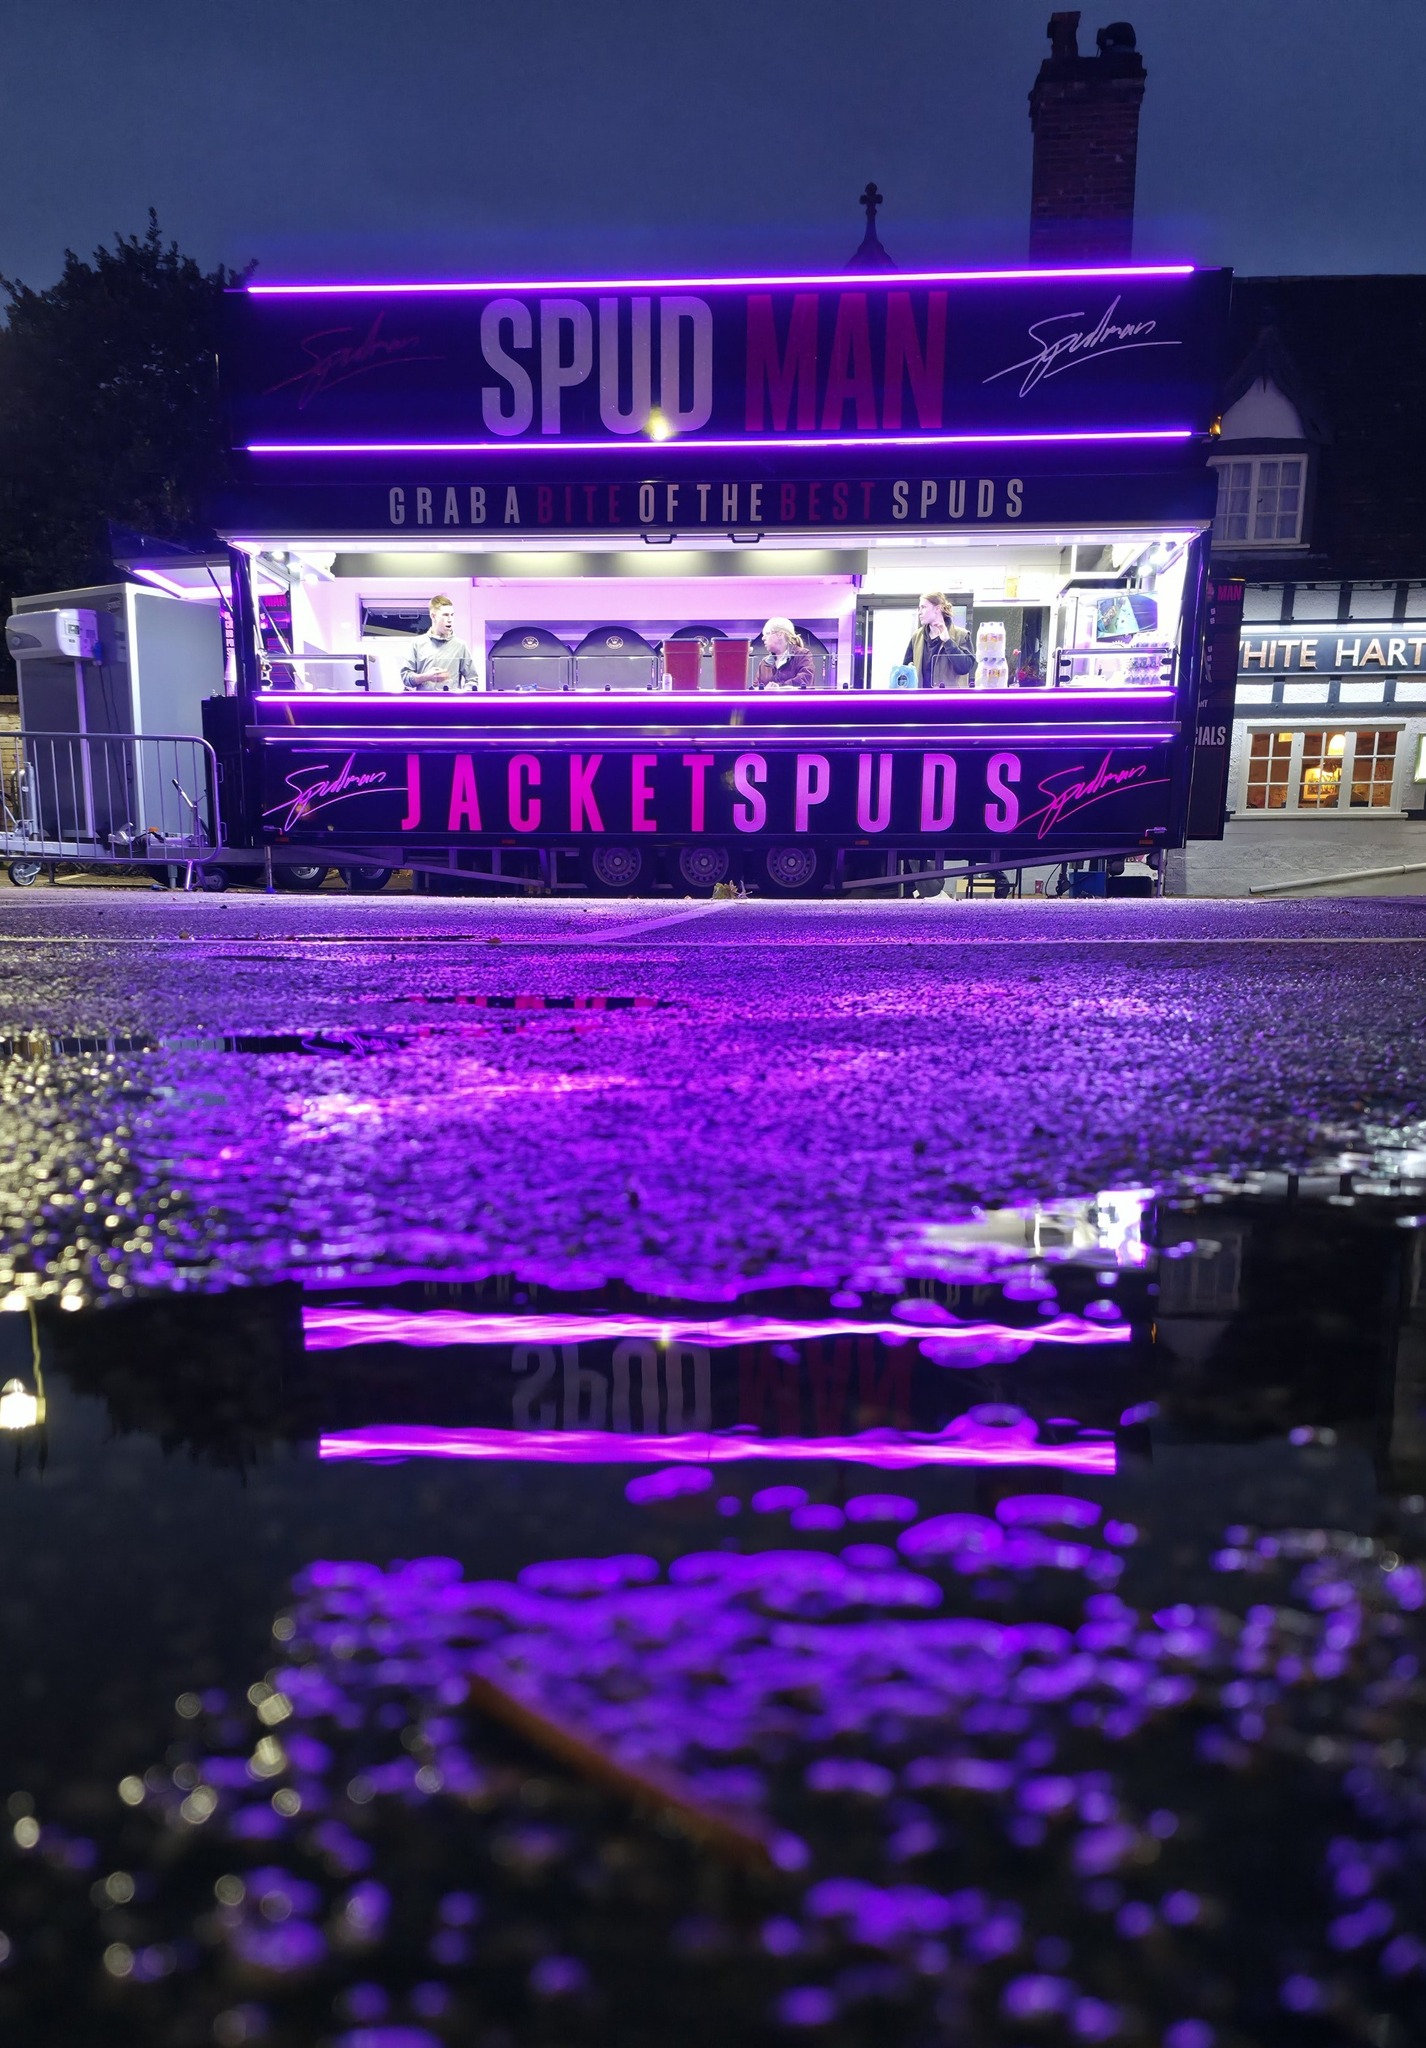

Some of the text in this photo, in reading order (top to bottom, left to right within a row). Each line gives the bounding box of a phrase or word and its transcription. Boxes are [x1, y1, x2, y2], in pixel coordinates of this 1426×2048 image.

[480, 291, 948, 436] SPUD MAN
[389, 478, 1025, 525] GRAB A BITE OF THE BEST SPUDS
[1217, 585, 1243, 601] MAN
[1239, 638, 1319, 669] HITE
[1334, 637, 1426, 668] HART
